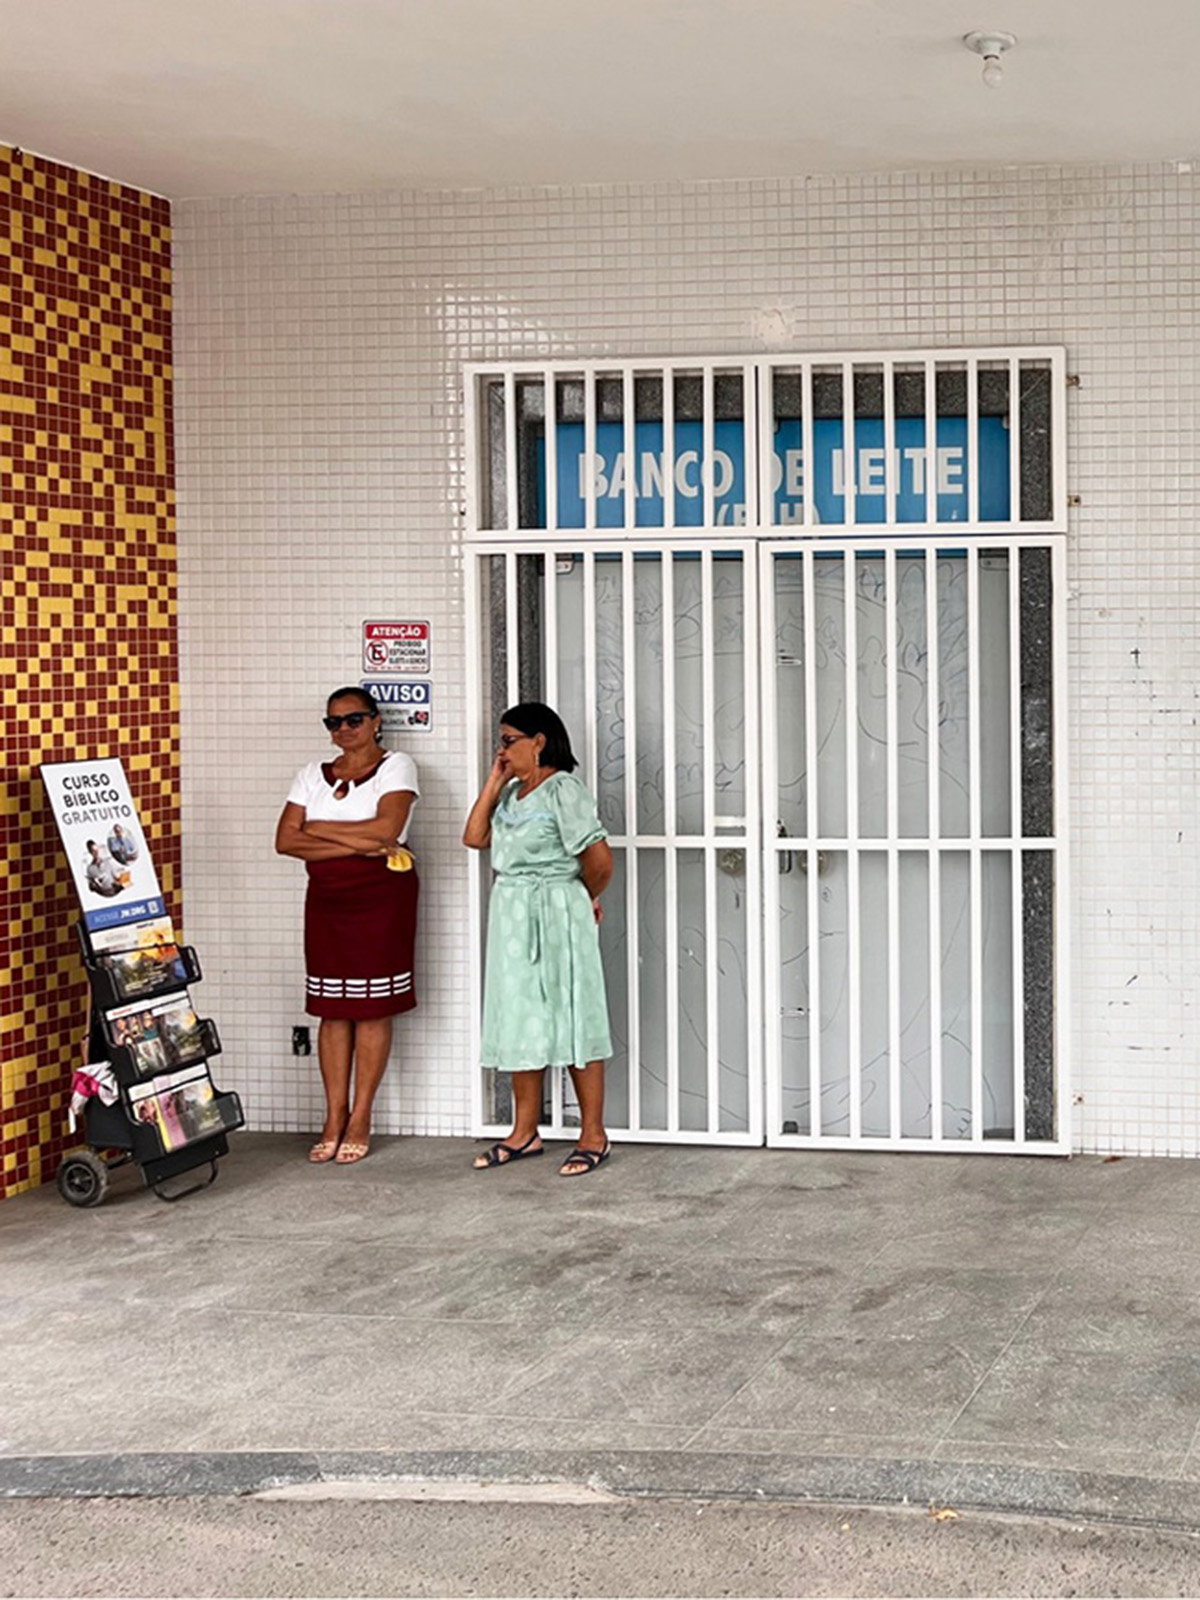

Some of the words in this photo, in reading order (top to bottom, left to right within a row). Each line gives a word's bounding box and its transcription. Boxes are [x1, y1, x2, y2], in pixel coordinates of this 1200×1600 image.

[578, 449, 735, 499] BANCO
[831, 446, 964, 496] LEITE
[372, 626, 421, 638] ATENÇÃO
[369, 684, 426, 702] AVISO
[61, 772, 111, 791] CURSO
[62, 788, 120, 809] BÍBLICO
[61, 804, 132, 826] GRATUITO
